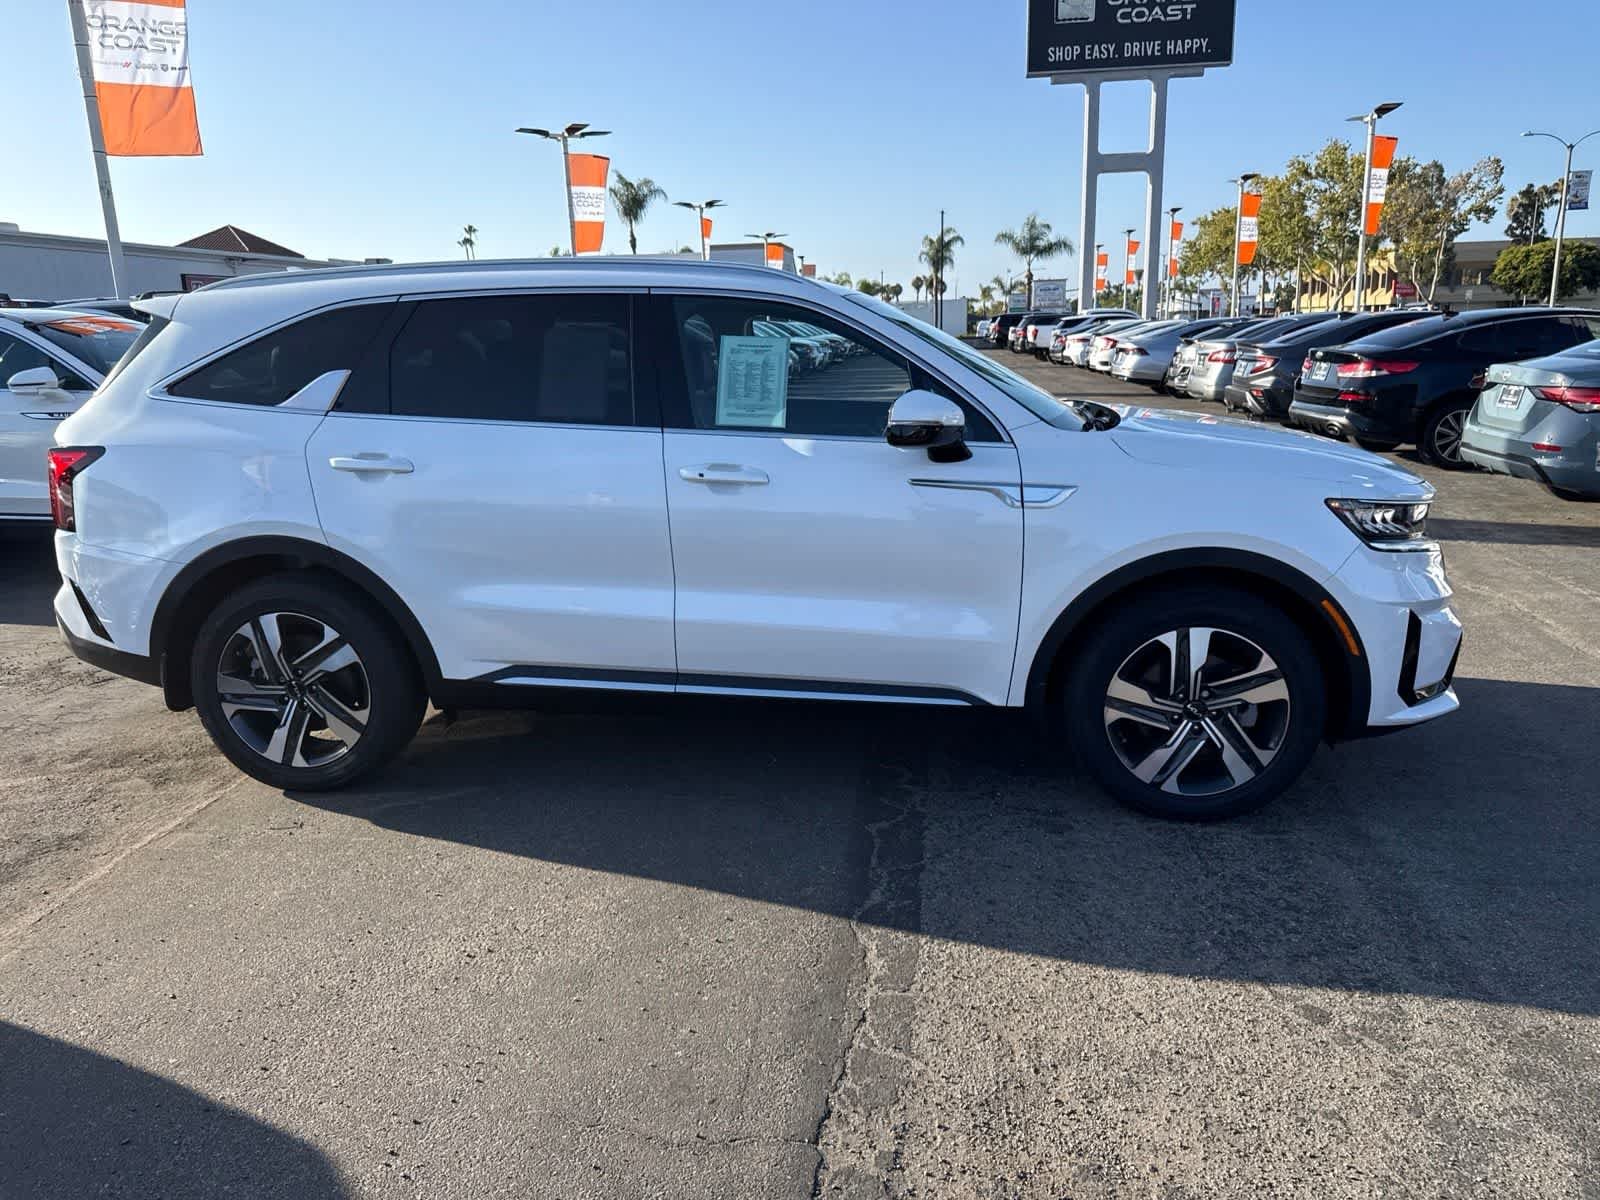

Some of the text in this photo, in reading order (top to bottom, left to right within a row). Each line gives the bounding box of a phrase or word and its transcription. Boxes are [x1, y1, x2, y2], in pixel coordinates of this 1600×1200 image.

[1116, 4, 1197, 23] COAST
[98, 33, 180, 55] COAST
[1048, 38, 1212, 62] SHOP EASY. DRIVE HAPPY.
